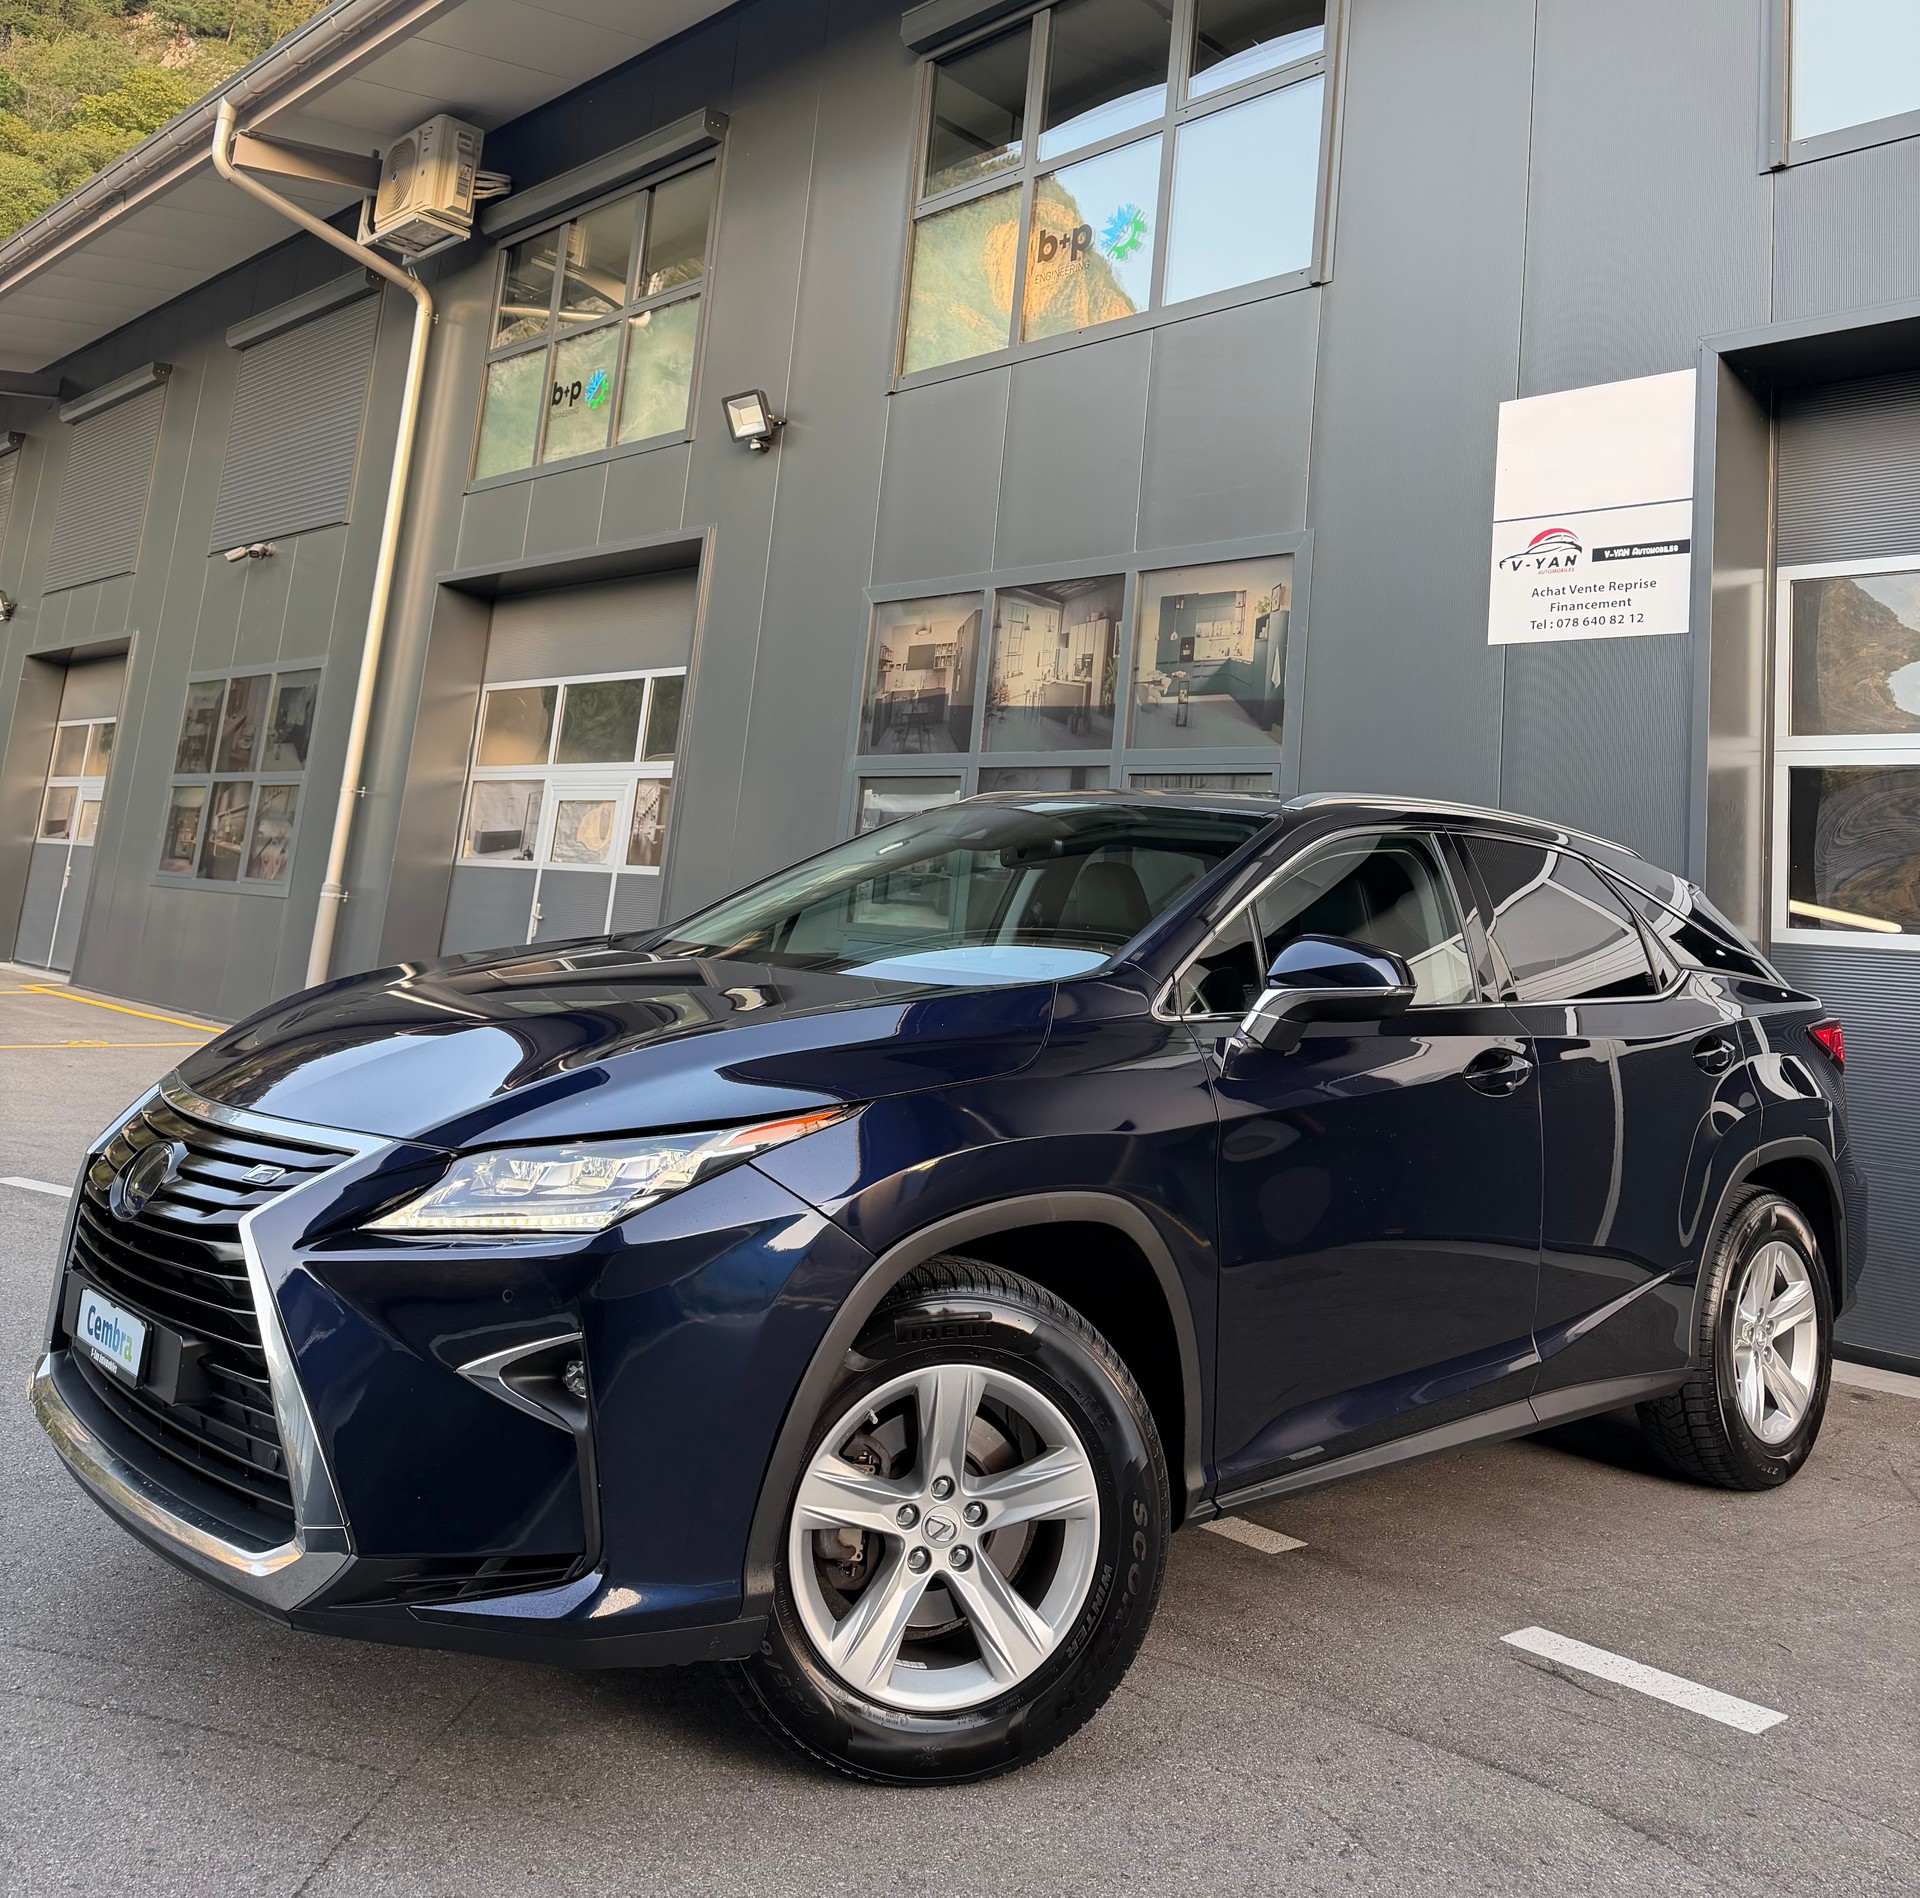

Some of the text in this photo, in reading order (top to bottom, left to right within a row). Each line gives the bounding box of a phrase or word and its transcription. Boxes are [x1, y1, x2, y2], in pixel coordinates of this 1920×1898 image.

[1037, 223, 1092, 263] b+p
[1035, 260, 1090, 284] ENGINEERING
[551, 380, 582, 407] b+p
[1603, 547, 1630, 558] V-YAN
[1537, 567, 1575, 575] AUTOMOBILES
[1531, 578, 1657, 598] Achat Vente Reprise
[1550, 597, 1632, 612] Financement
[1556, 617, 1579, 628] 078
[1582, 615, 1606, 626] 640
[1609, 614, 1625, 625] 82
[1630, 612, 1644, 623] 12
[87, 1305, 133, 1362] Cembra
[1066, 1562, 1114, 1660] WINTER
